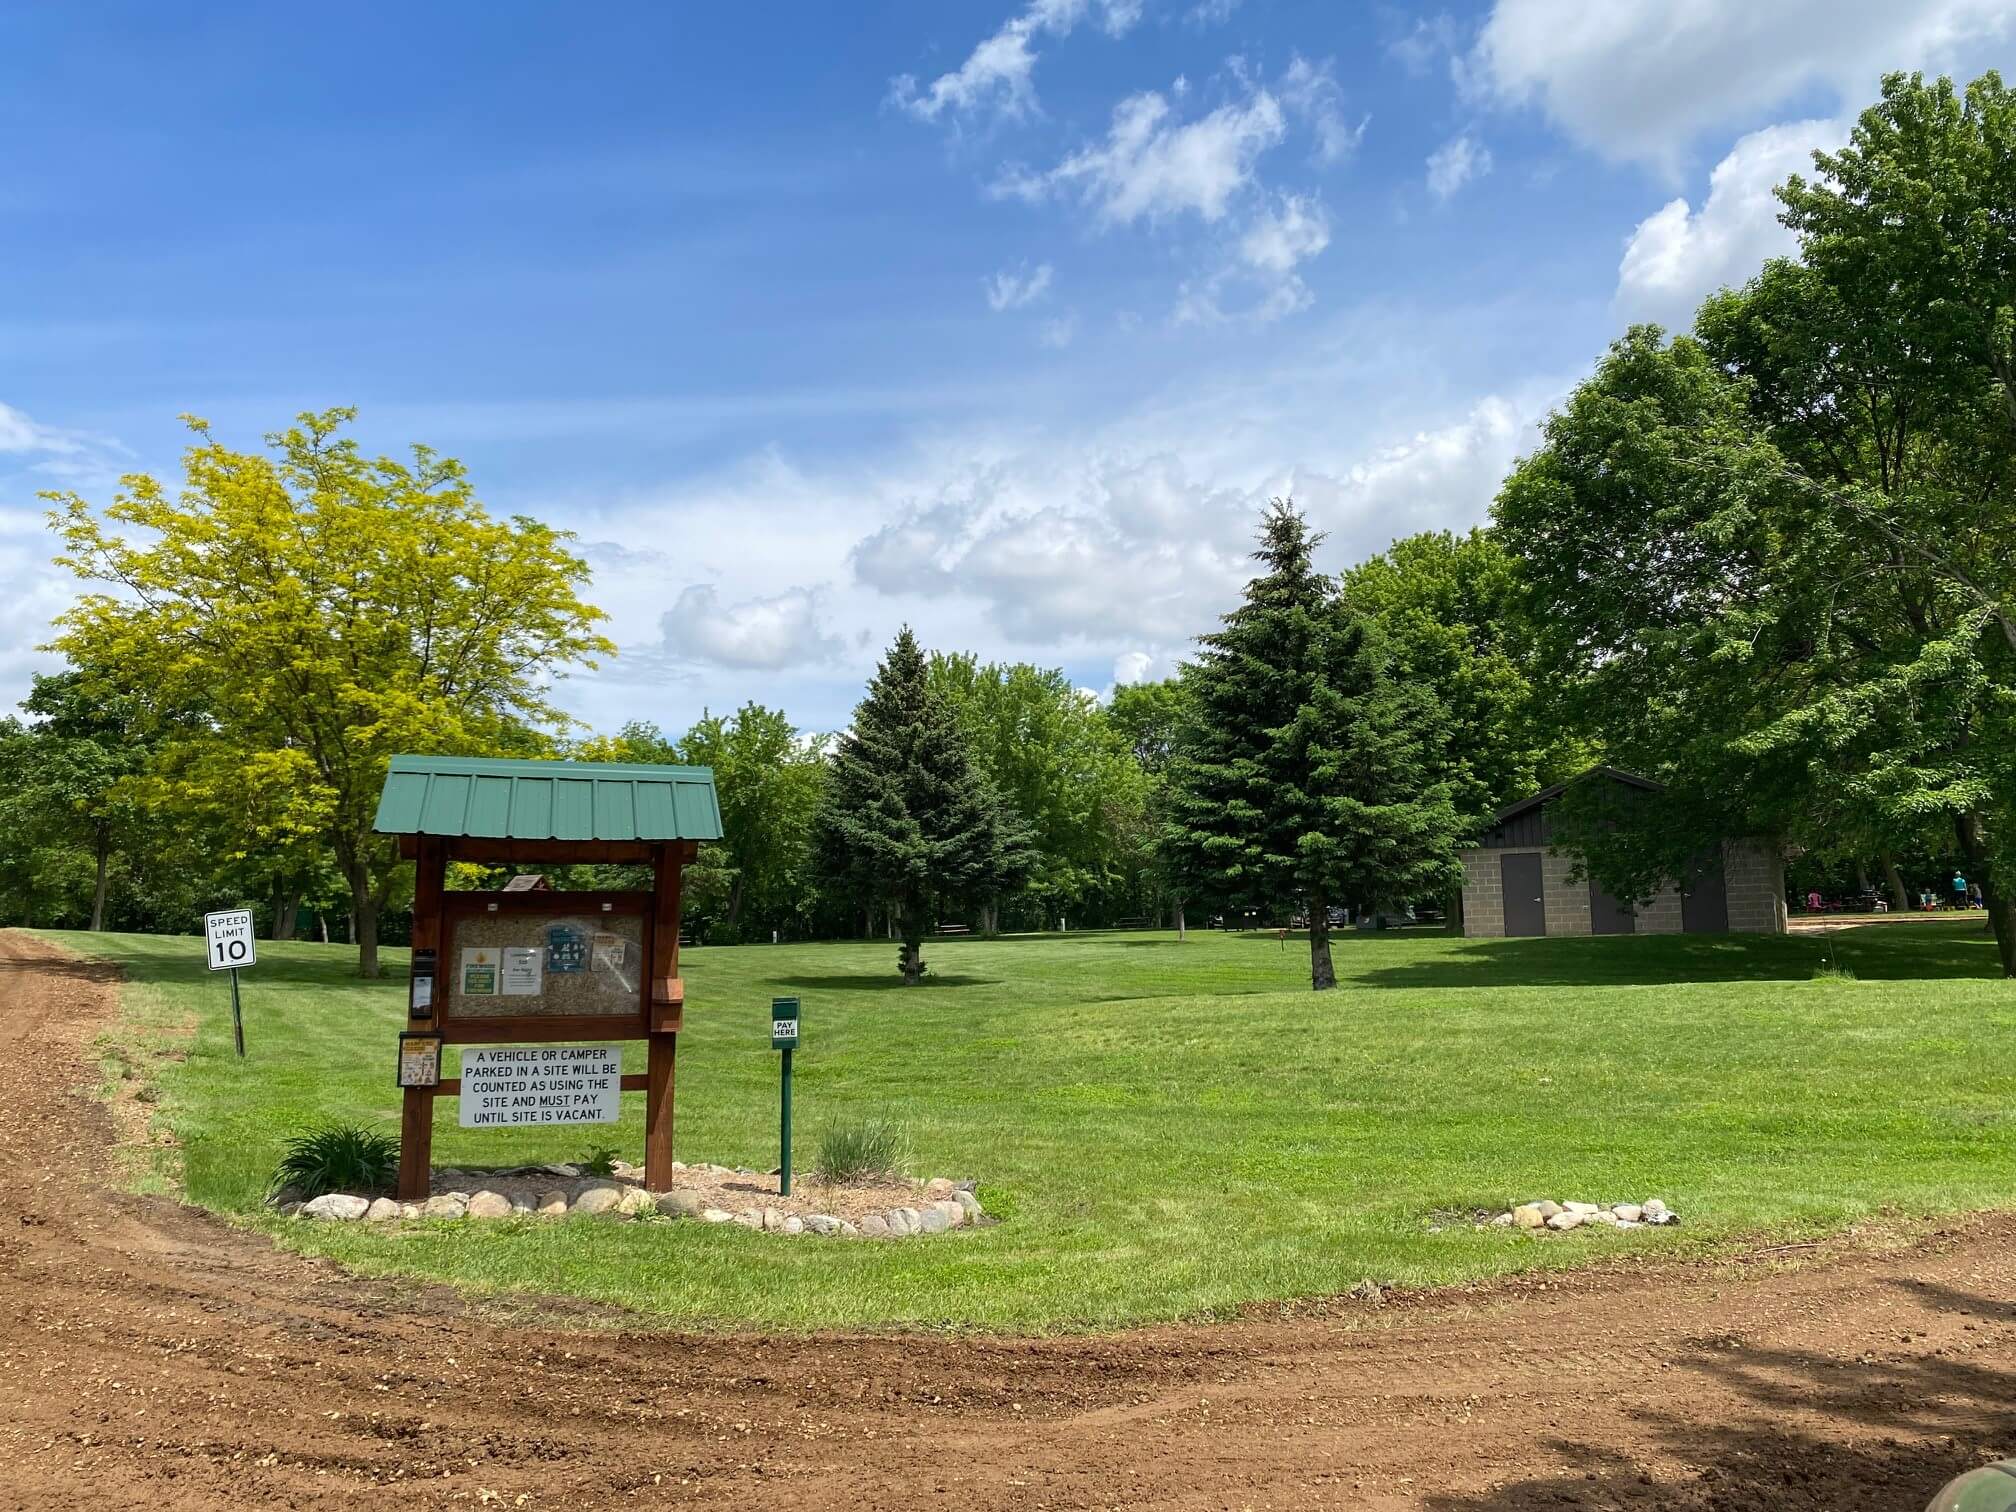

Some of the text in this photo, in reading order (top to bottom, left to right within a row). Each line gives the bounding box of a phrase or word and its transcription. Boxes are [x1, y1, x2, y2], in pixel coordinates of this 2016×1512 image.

[211, 916, 247, 927] SPEED
[215, 928, 244, 938] LIMIT
[216, 940, 246, 961] 10
[477, 1050, 607, 1062] A VEHICLE OR CAMPER
[466, 1064, 616, 1078] PARKED IN A SITE WILL BE
[473, 1079, 608, 1093] COUNTED AS USING THE
[482, 1094, 598, 1108] SITE AND MUST PAY
[474, 1112, 508, 1123] UNTIL
[512, 1111, 537, 1122] SITE
[541, 1111, 552, 1121] IS
